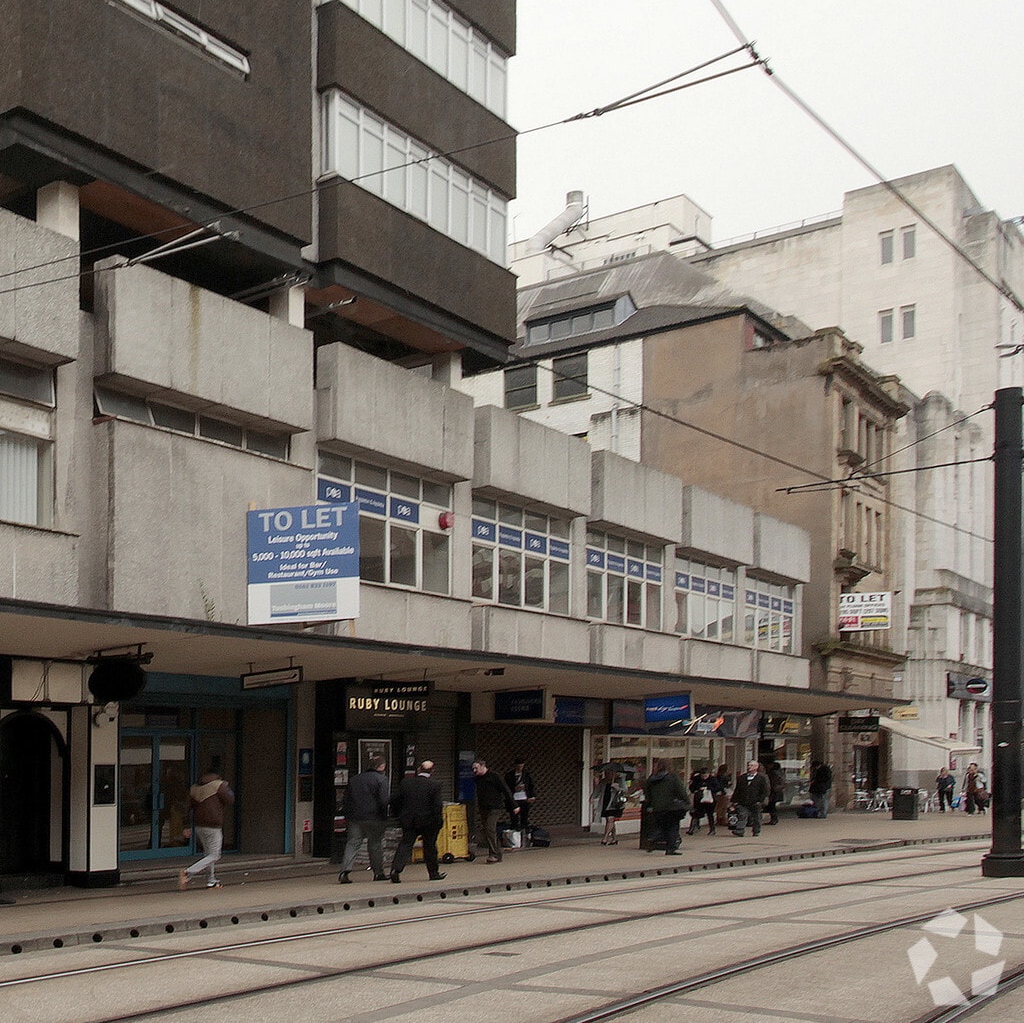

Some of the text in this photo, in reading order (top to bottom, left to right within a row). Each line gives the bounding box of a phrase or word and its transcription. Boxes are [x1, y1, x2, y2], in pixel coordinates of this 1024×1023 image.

[257, 506, 348, 533] TO LET
[267, 531, 339, 545] Leisure Opportunity
[252, 552, 275, 562] 5,000
[280, 549, 306, 561] 10,000
[321, 546, 355, 557] Available
[840, 593, 886, 604] TO LET
[349, 697, 427, 711] RUBY LOUNGE
